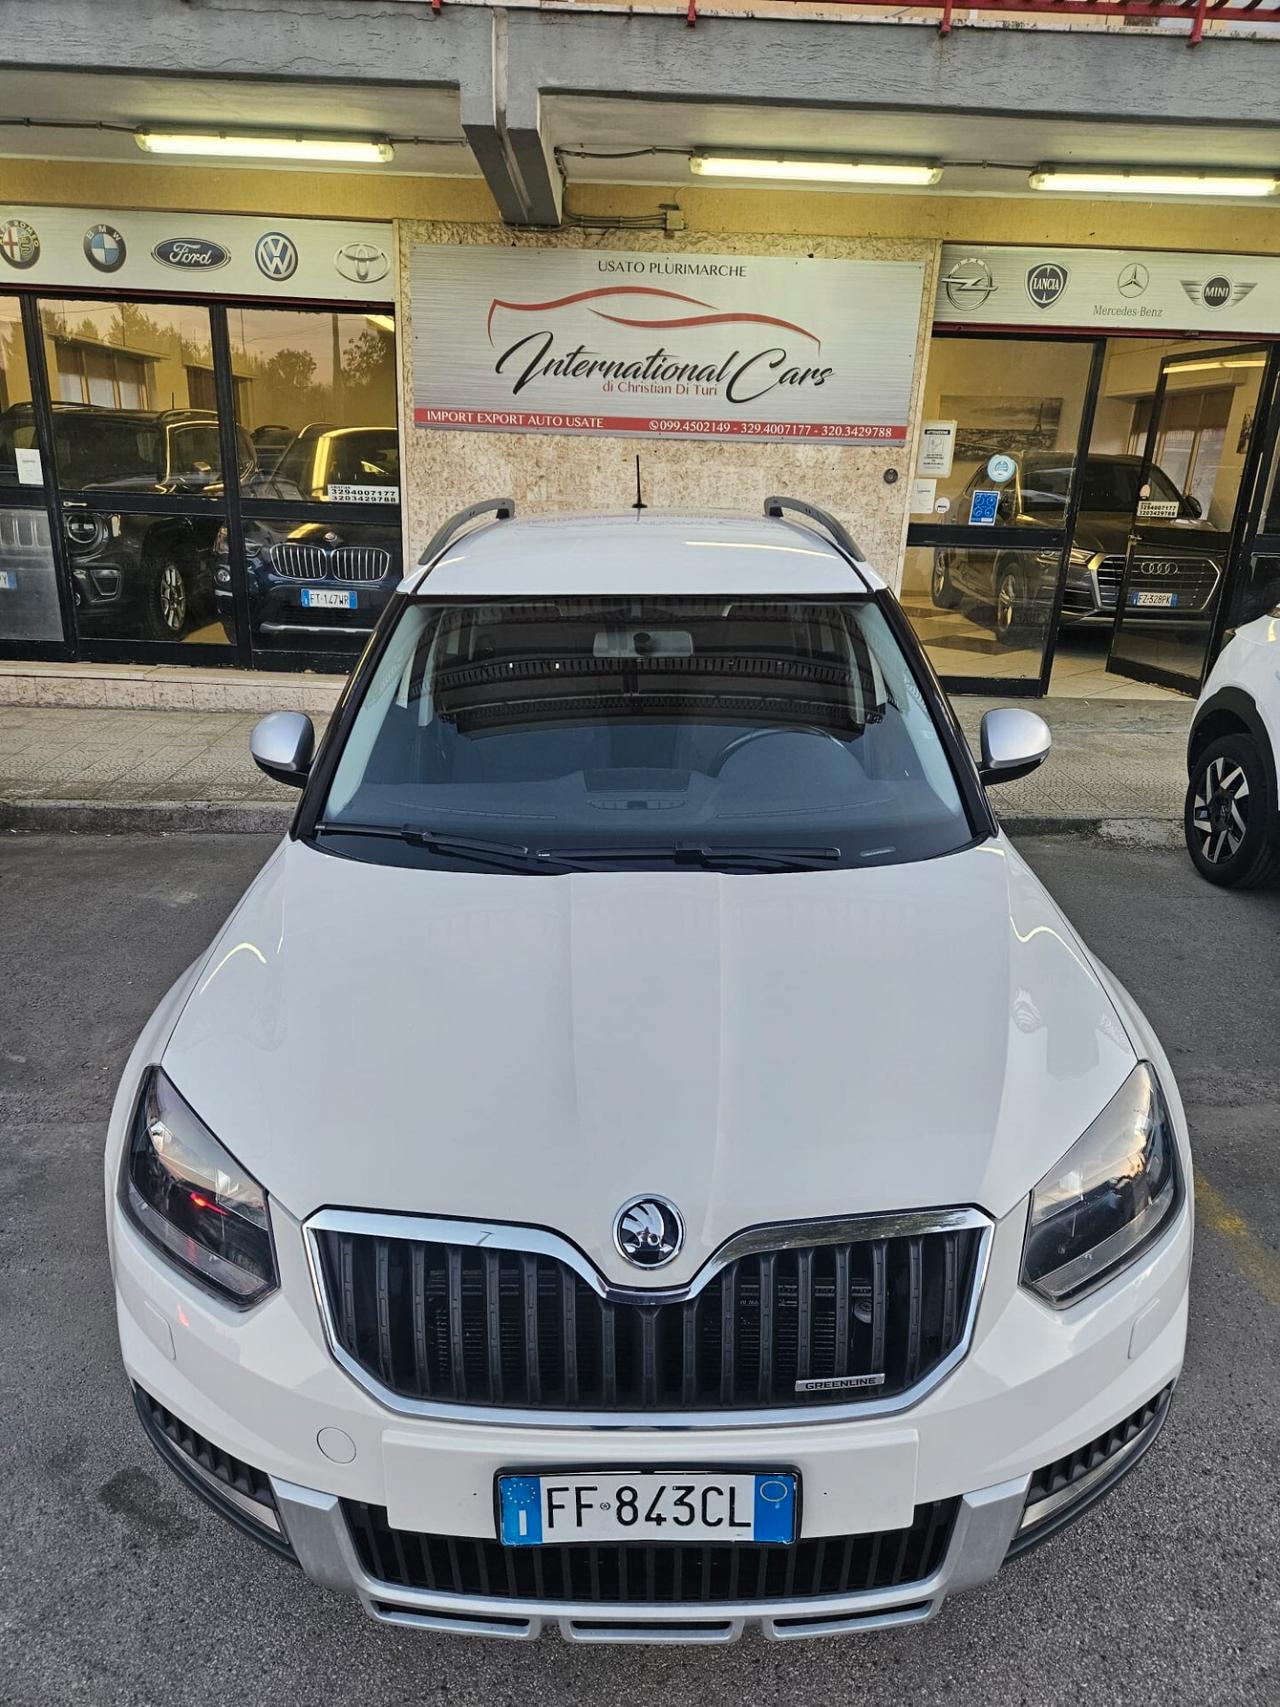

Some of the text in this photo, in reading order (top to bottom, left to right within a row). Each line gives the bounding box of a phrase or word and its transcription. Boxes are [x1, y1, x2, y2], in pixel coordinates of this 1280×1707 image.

[86, 224, 121, 241] BMW
[169, 241, 213, 265] Ford
[598, 260, 748, 277] USATO PLURIMARCHE
[1032, 277, 1060, 290] LANCIA
[1205, 286, 1229, 297] MINI
[495, 330, 836, 404] International Cars
[602, 381, 718, 396] di Christian Di Turi
[427, 410, 604, 428] IMPORT EXPORT AUTO USATE
[660, 420, 731, 433] 099.4502149
[740, 422, 812, 436] 329.4007177
[821, 425, 892, 438] 320.3429788
[331, 488, 396, 496] 3294007177
[805, 1377, 877, 1389] GREENLINE
[546, 1486, 599, 1529] FF
[615, 1485, 752, 1528] 843CL
